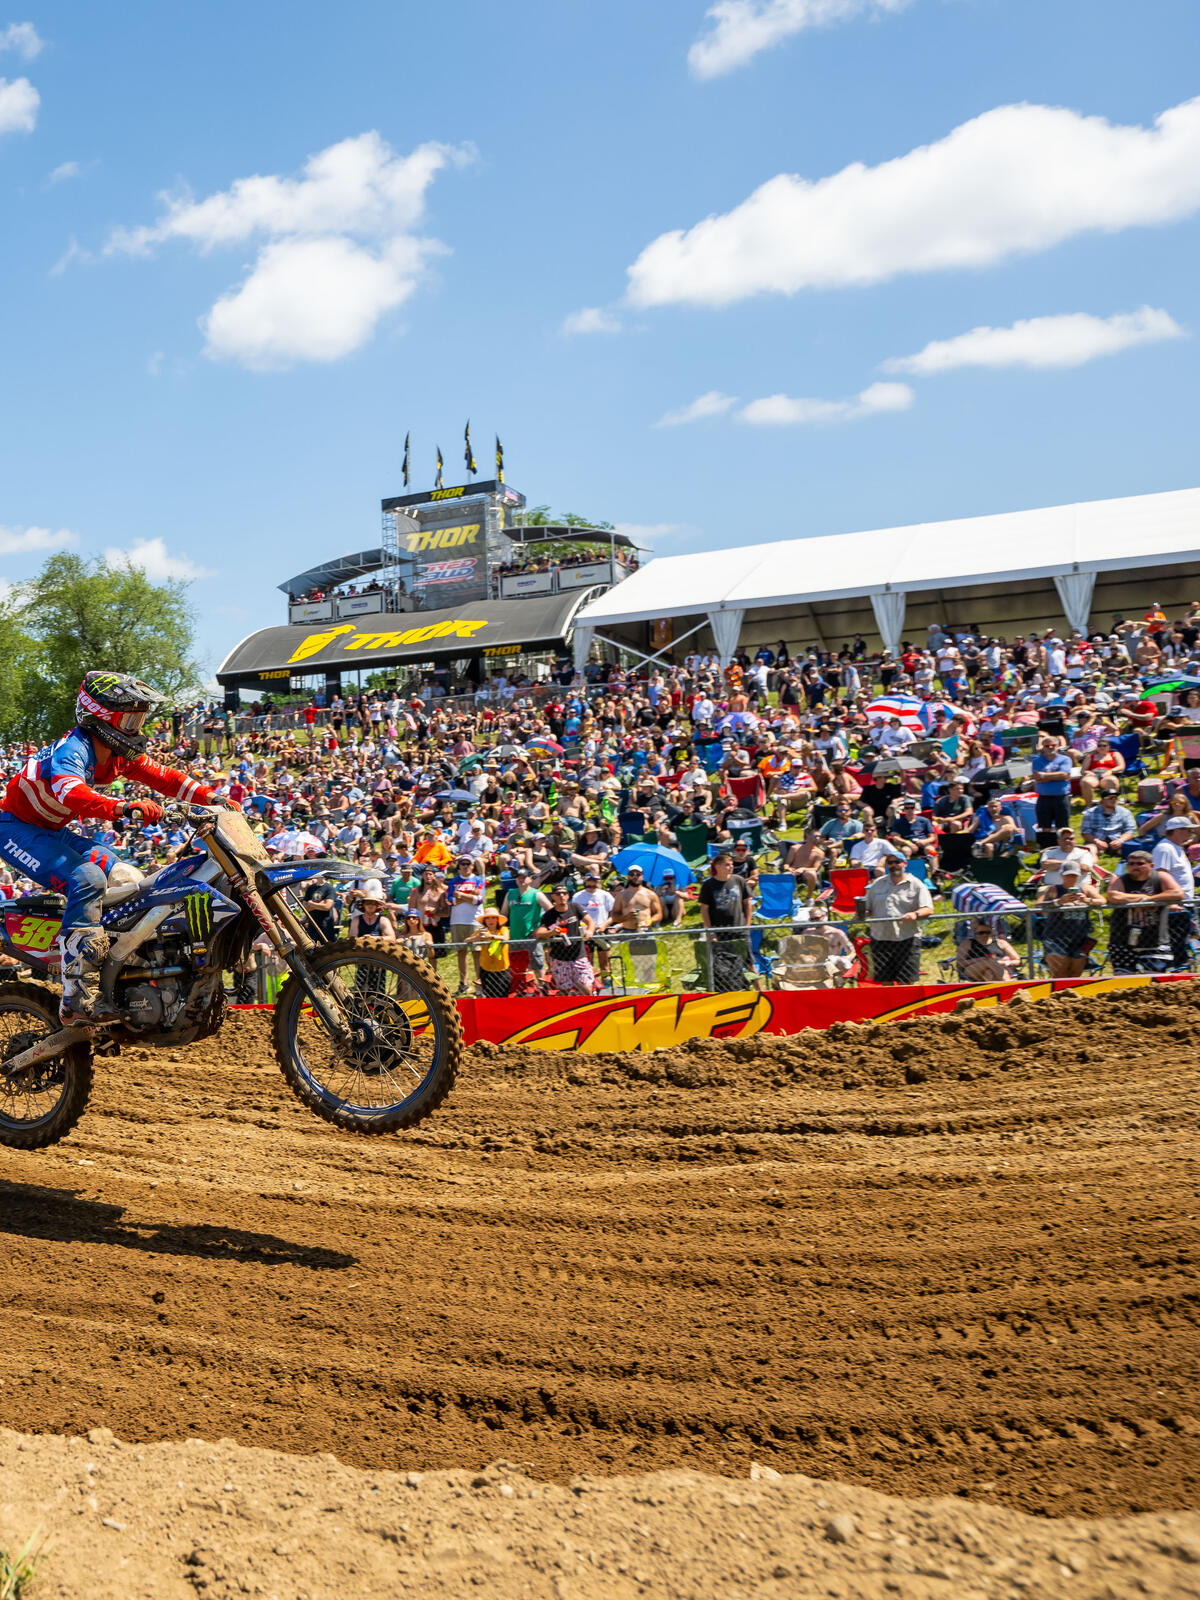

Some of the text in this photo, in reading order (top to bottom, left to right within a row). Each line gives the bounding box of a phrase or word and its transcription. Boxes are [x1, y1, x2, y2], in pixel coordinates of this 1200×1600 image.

[430, 486, 465, 501] THOR
[406, 523, 481, 553] THOR
[425, 557, 478, 573] RED
[344, 620, 488, 650] THOR
[482, 645, 522, 657] THOR
[258, 669, 291, 681] THOR
[78, 690, 112, 721] 100%
[3, 838, 41, 873] THOR
[11, 917, 62, 950] 38
